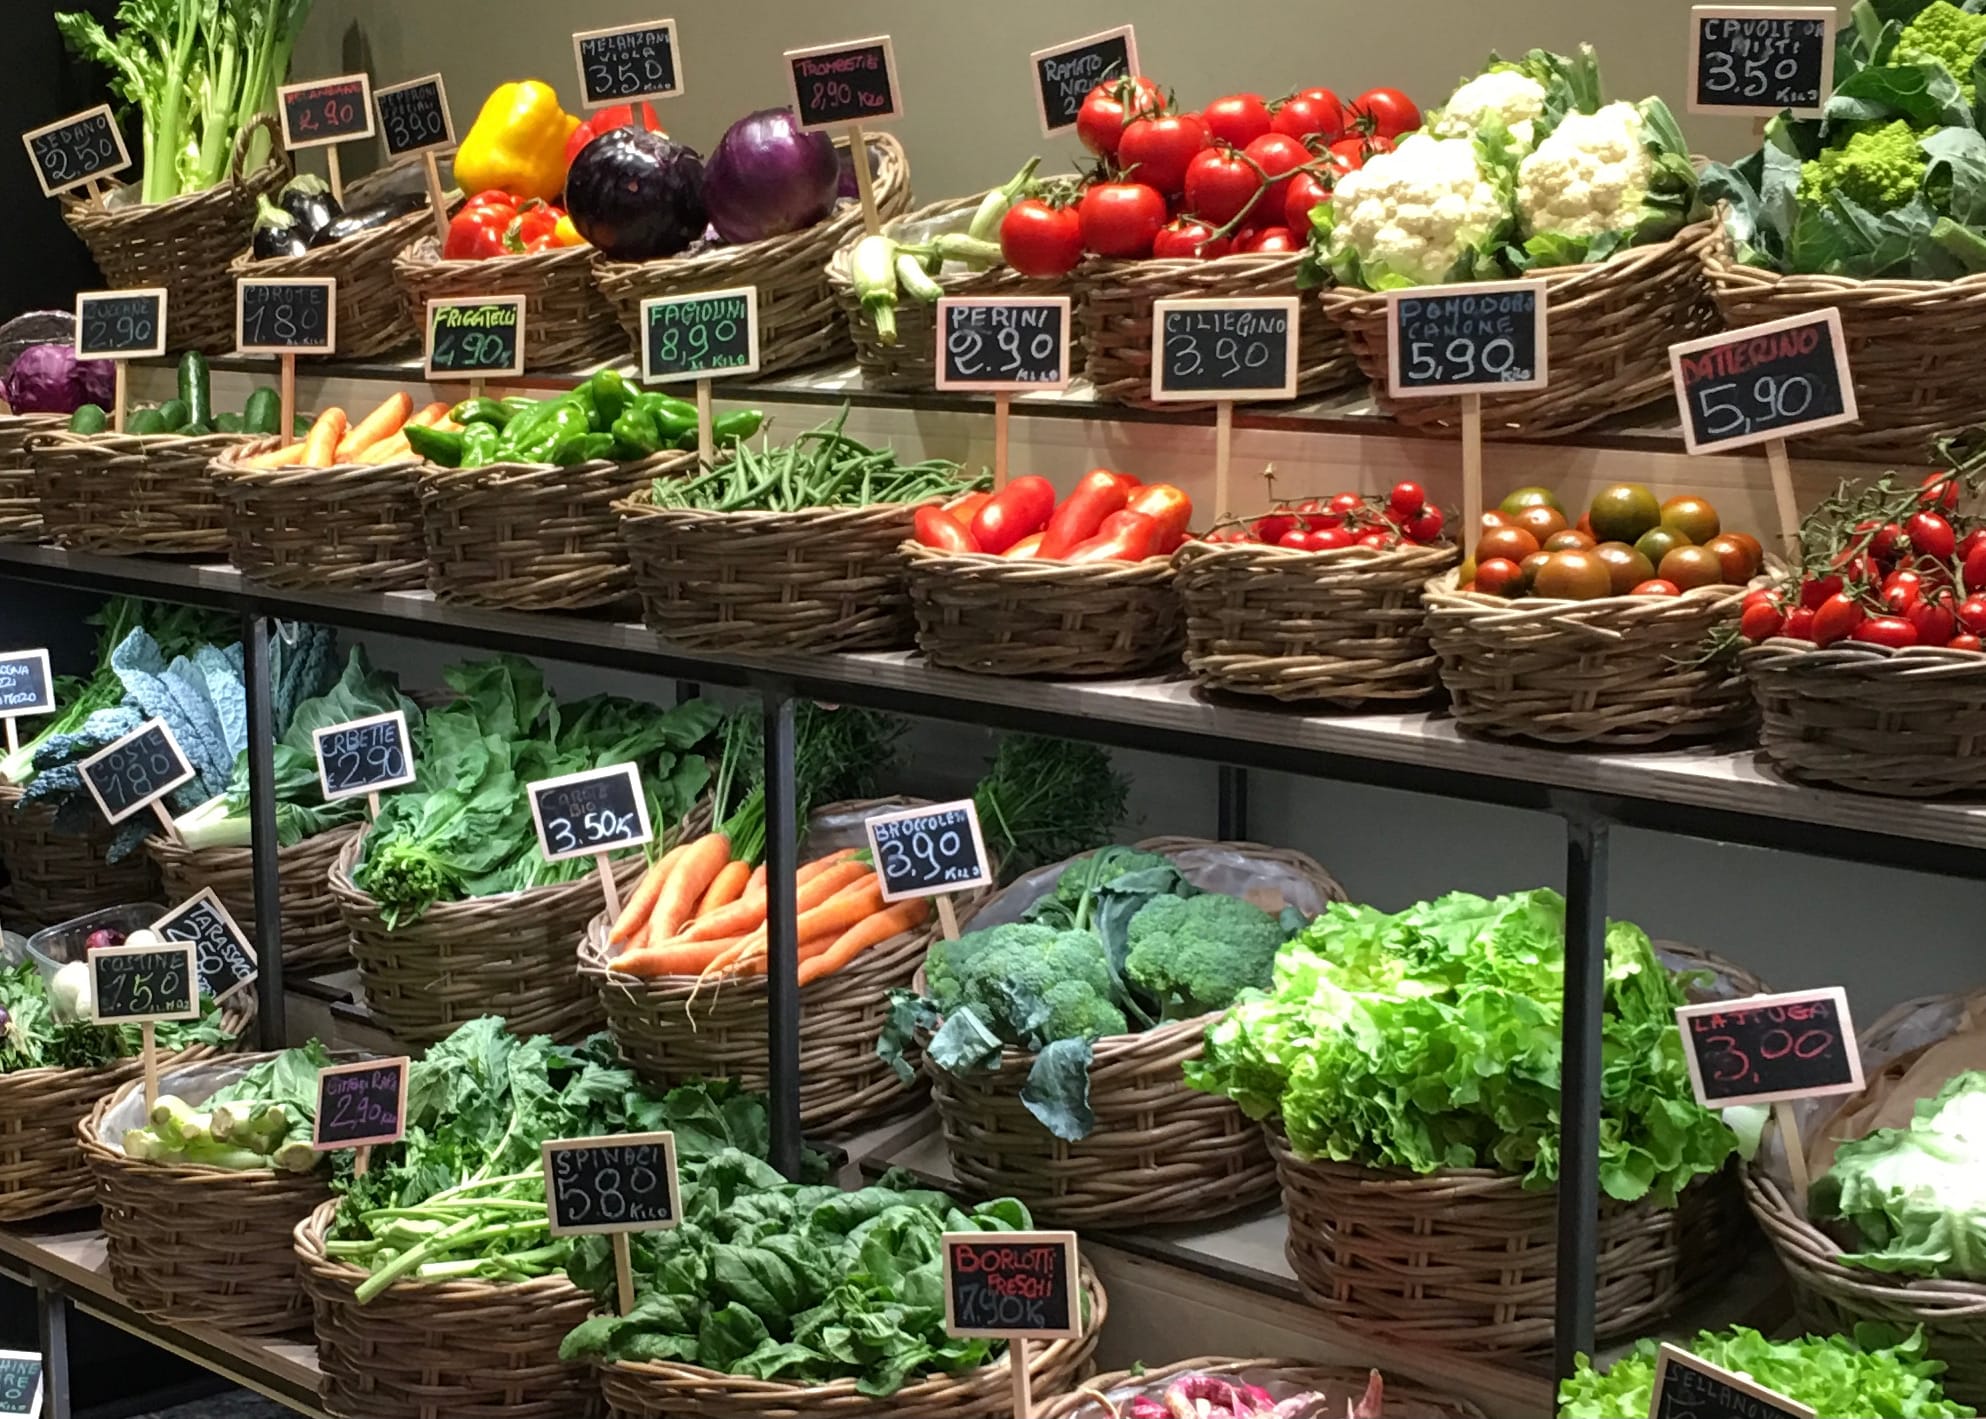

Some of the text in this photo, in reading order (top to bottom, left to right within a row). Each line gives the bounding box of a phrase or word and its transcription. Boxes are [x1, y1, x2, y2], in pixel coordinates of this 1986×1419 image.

[601, 47, 656, 63] VIOLA
[37, 116, 108, 156] SEDANO
[245, 286, 321, 305] CAROTE
[952, 306, 1048, 329] PERINI
[1166, 312, 1286, 337] CILIEGINO
[1699, 375, 1813, 435] 5,90
